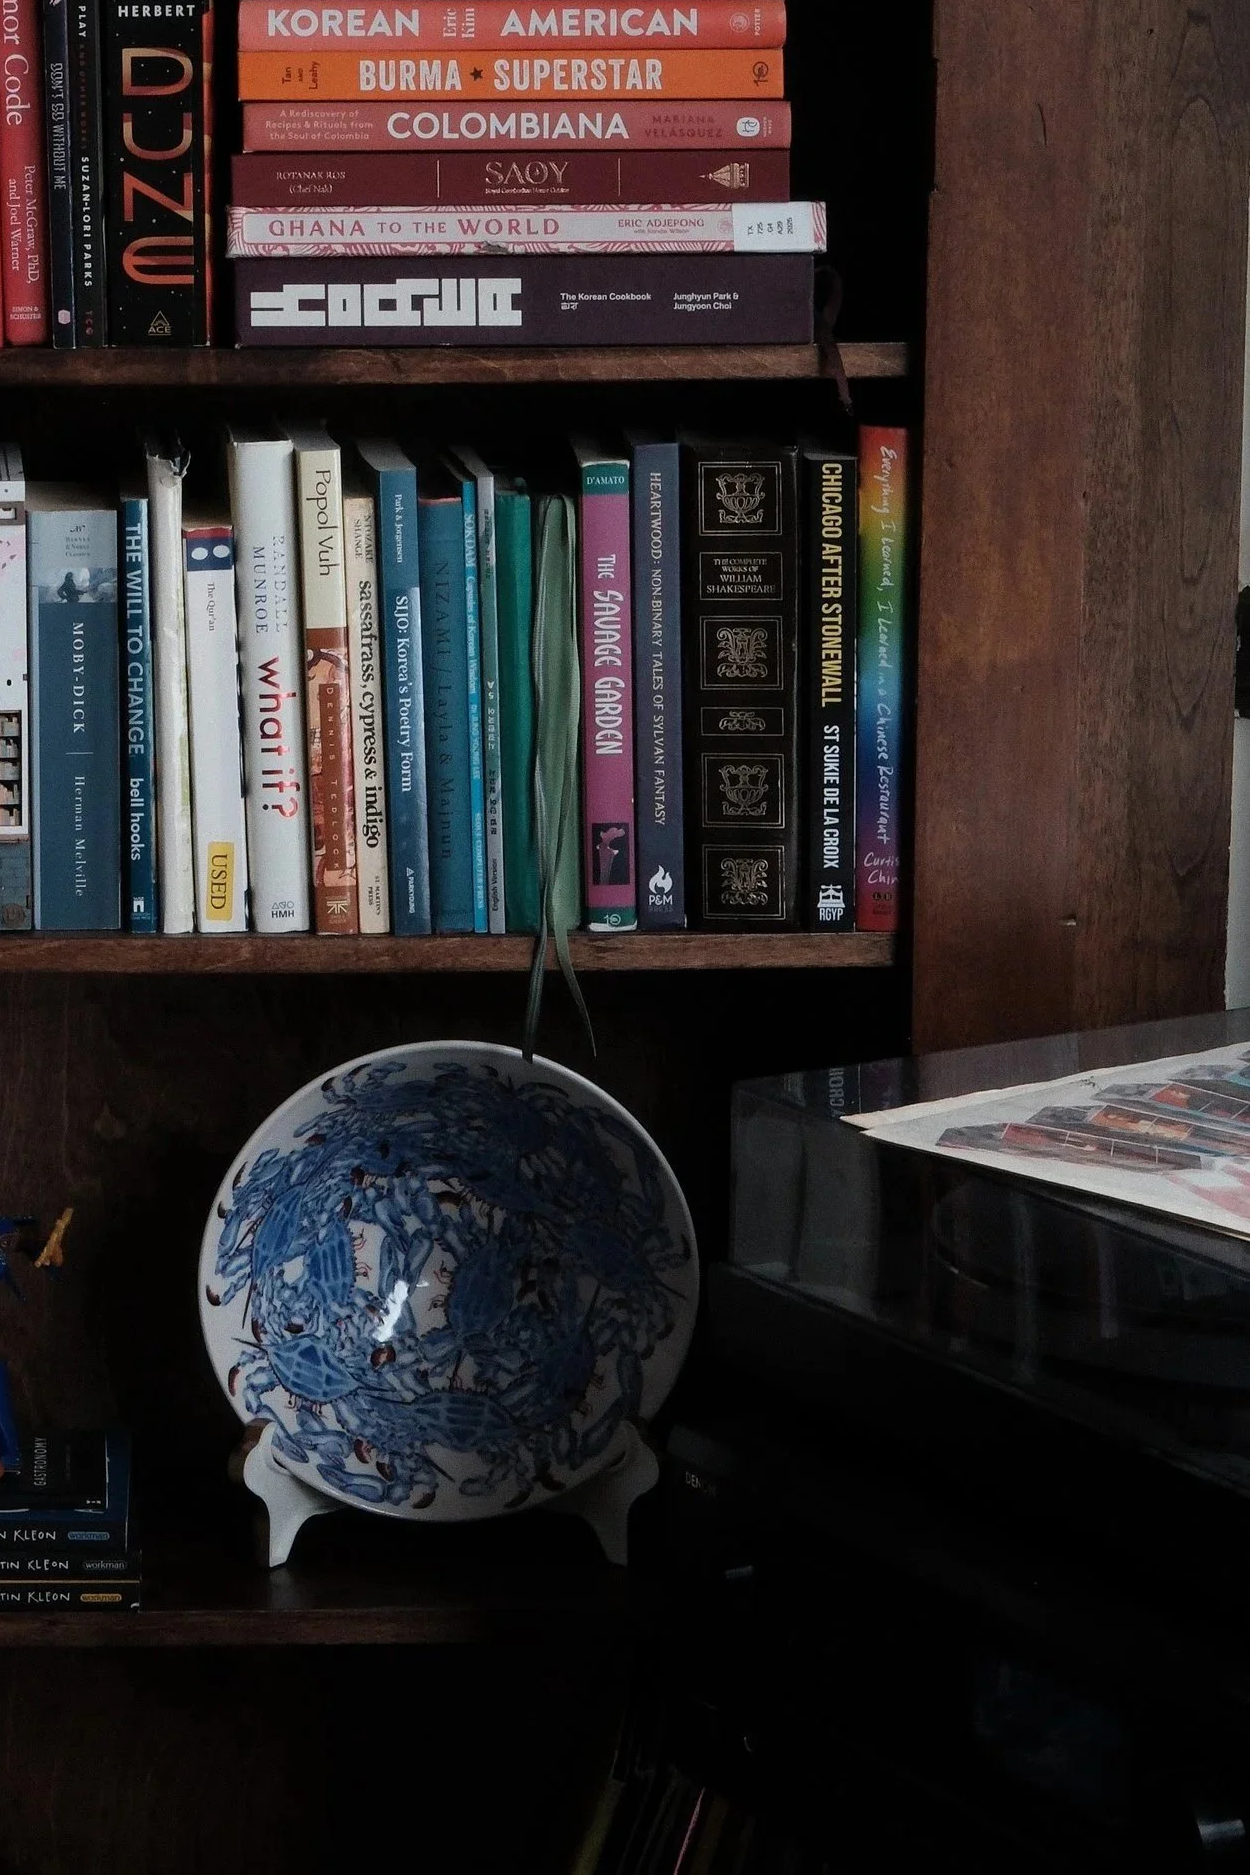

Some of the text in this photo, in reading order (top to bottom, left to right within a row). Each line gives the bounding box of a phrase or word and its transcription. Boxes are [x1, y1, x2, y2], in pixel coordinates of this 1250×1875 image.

[117, 5, 195, 17] HERBERT
[268, 8, 698, 37] KOREAN AMERICAN
[4, 53, 28, 126] Code
[360, 59, 662, 91] BURMA SUPERSTAR
[388, 113, 629, 139] COLOMBIANA
[610, 293, 651, 301] Cookbook
[306, 469, 338, 576] Popol Vuh
[821, 463, 843, 707] CHICAGO AFTER STONEWALL
[125, 523, 144, 755] THE WILL TO CHANGE
[594, 554, 623, 755] THE SAVAGE GARDEN
[72, 622, 85, 734] MOBY-DICK
[257, 657, 297, 763] what
[360, 692, 379, 765] cypress
[129, 777, 145, 861] bell hooks
[362, 785, 382, 848] indigo
[823, 725, 840, 868] ST SUKIE DE LA CROIX
[210, 854, 229, 909] USED
[28, 1560, 69, 1570] KLEON
[85, 1561, 126, 1569] workman
